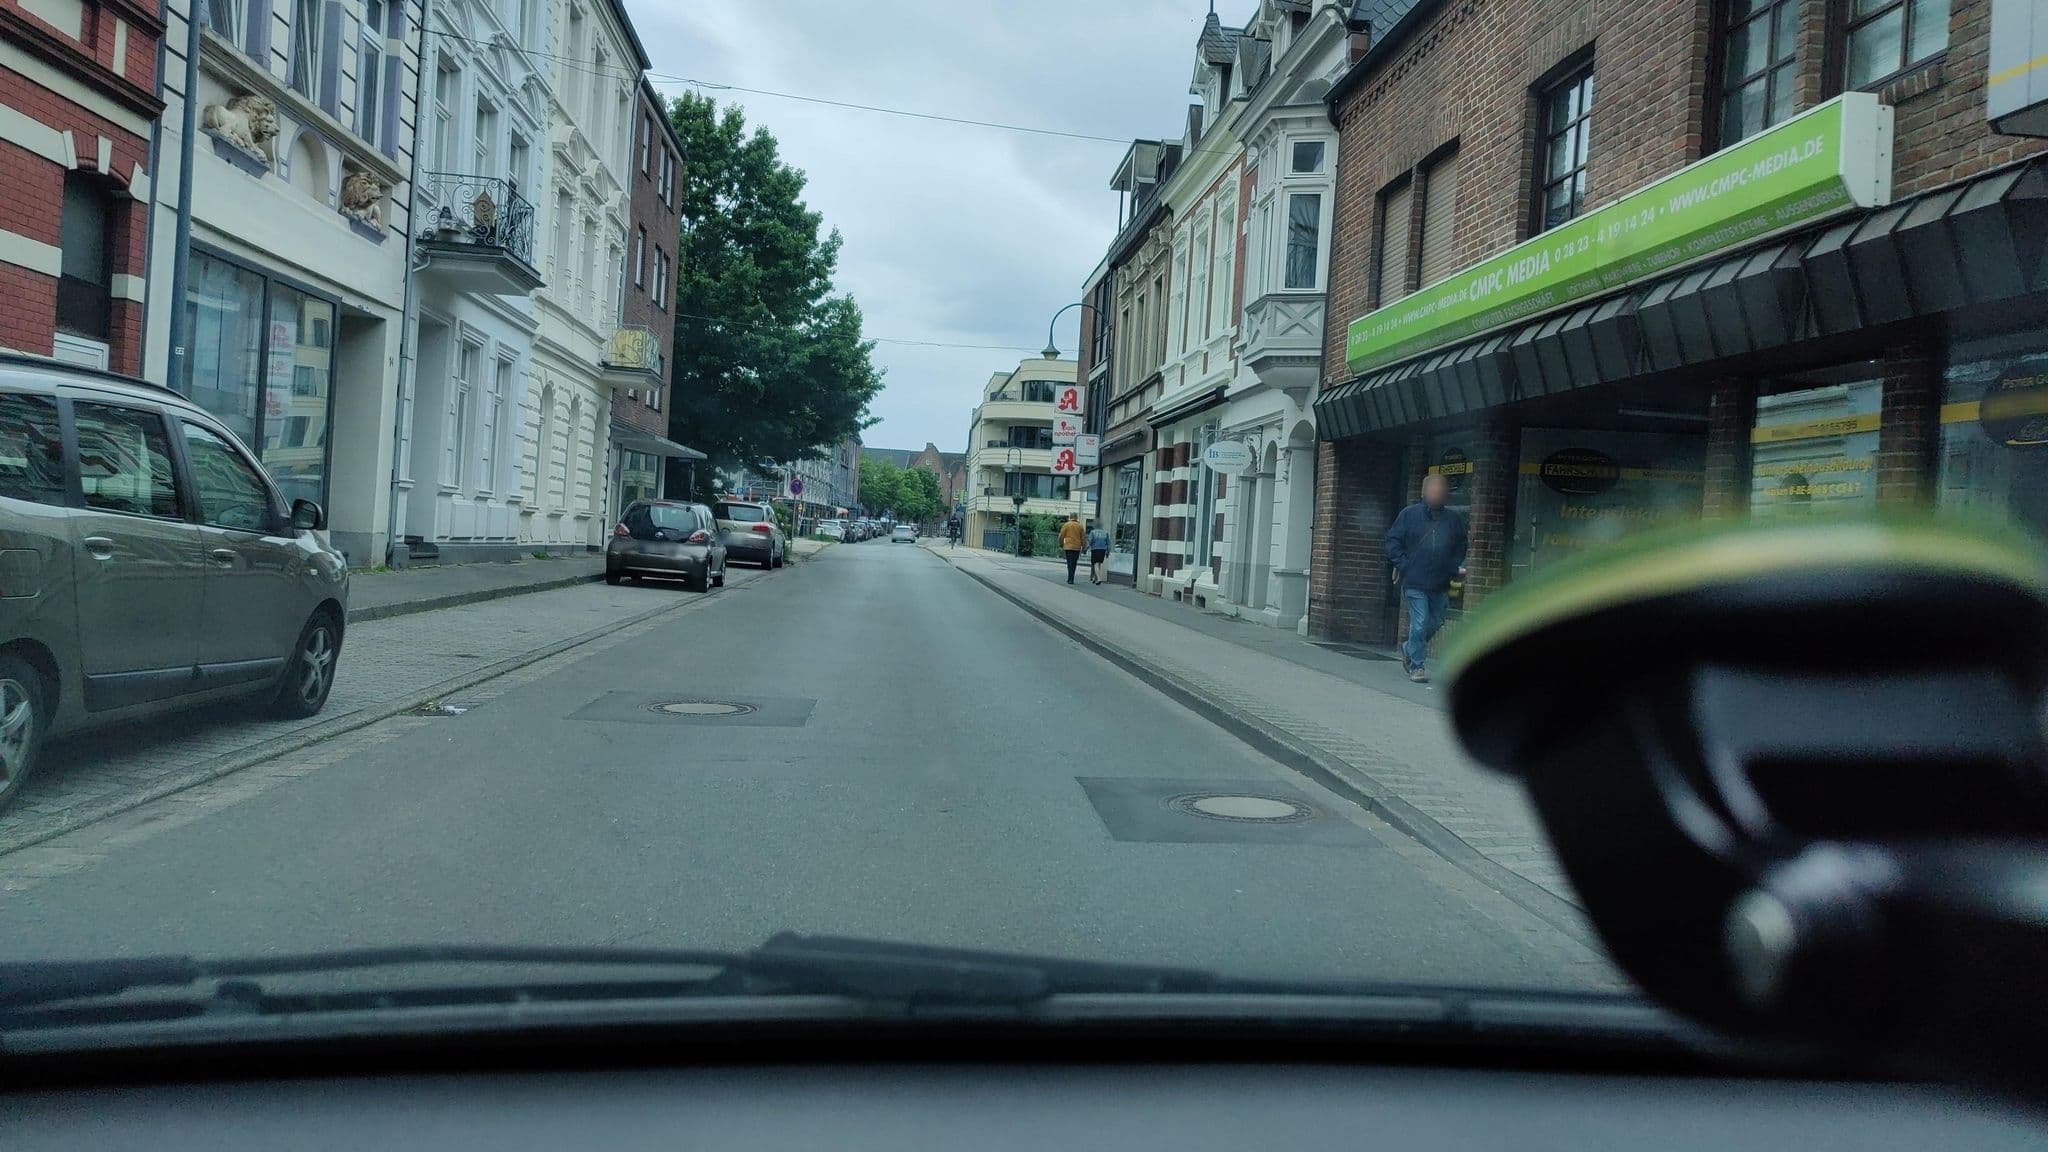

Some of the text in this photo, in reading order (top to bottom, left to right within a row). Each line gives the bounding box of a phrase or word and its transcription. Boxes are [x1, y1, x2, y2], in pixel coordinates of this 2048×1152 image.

[1554, 250, 1561, 263] 0
[1563, 242, 1574, 259] 28
[1577, 235, 1589, 252] 23
[1596, 229, 1605, 245] 4
[1608, 223, 1621, 239] 19
[1625, 213, 1637, 232] 14
[1641, 207, 1655, 226] 24
[1669, 135, 1825, 214] WWW.CMPC-MEDIA.DE
[1470, 249, 1550, 302] CMPC MEDIA
